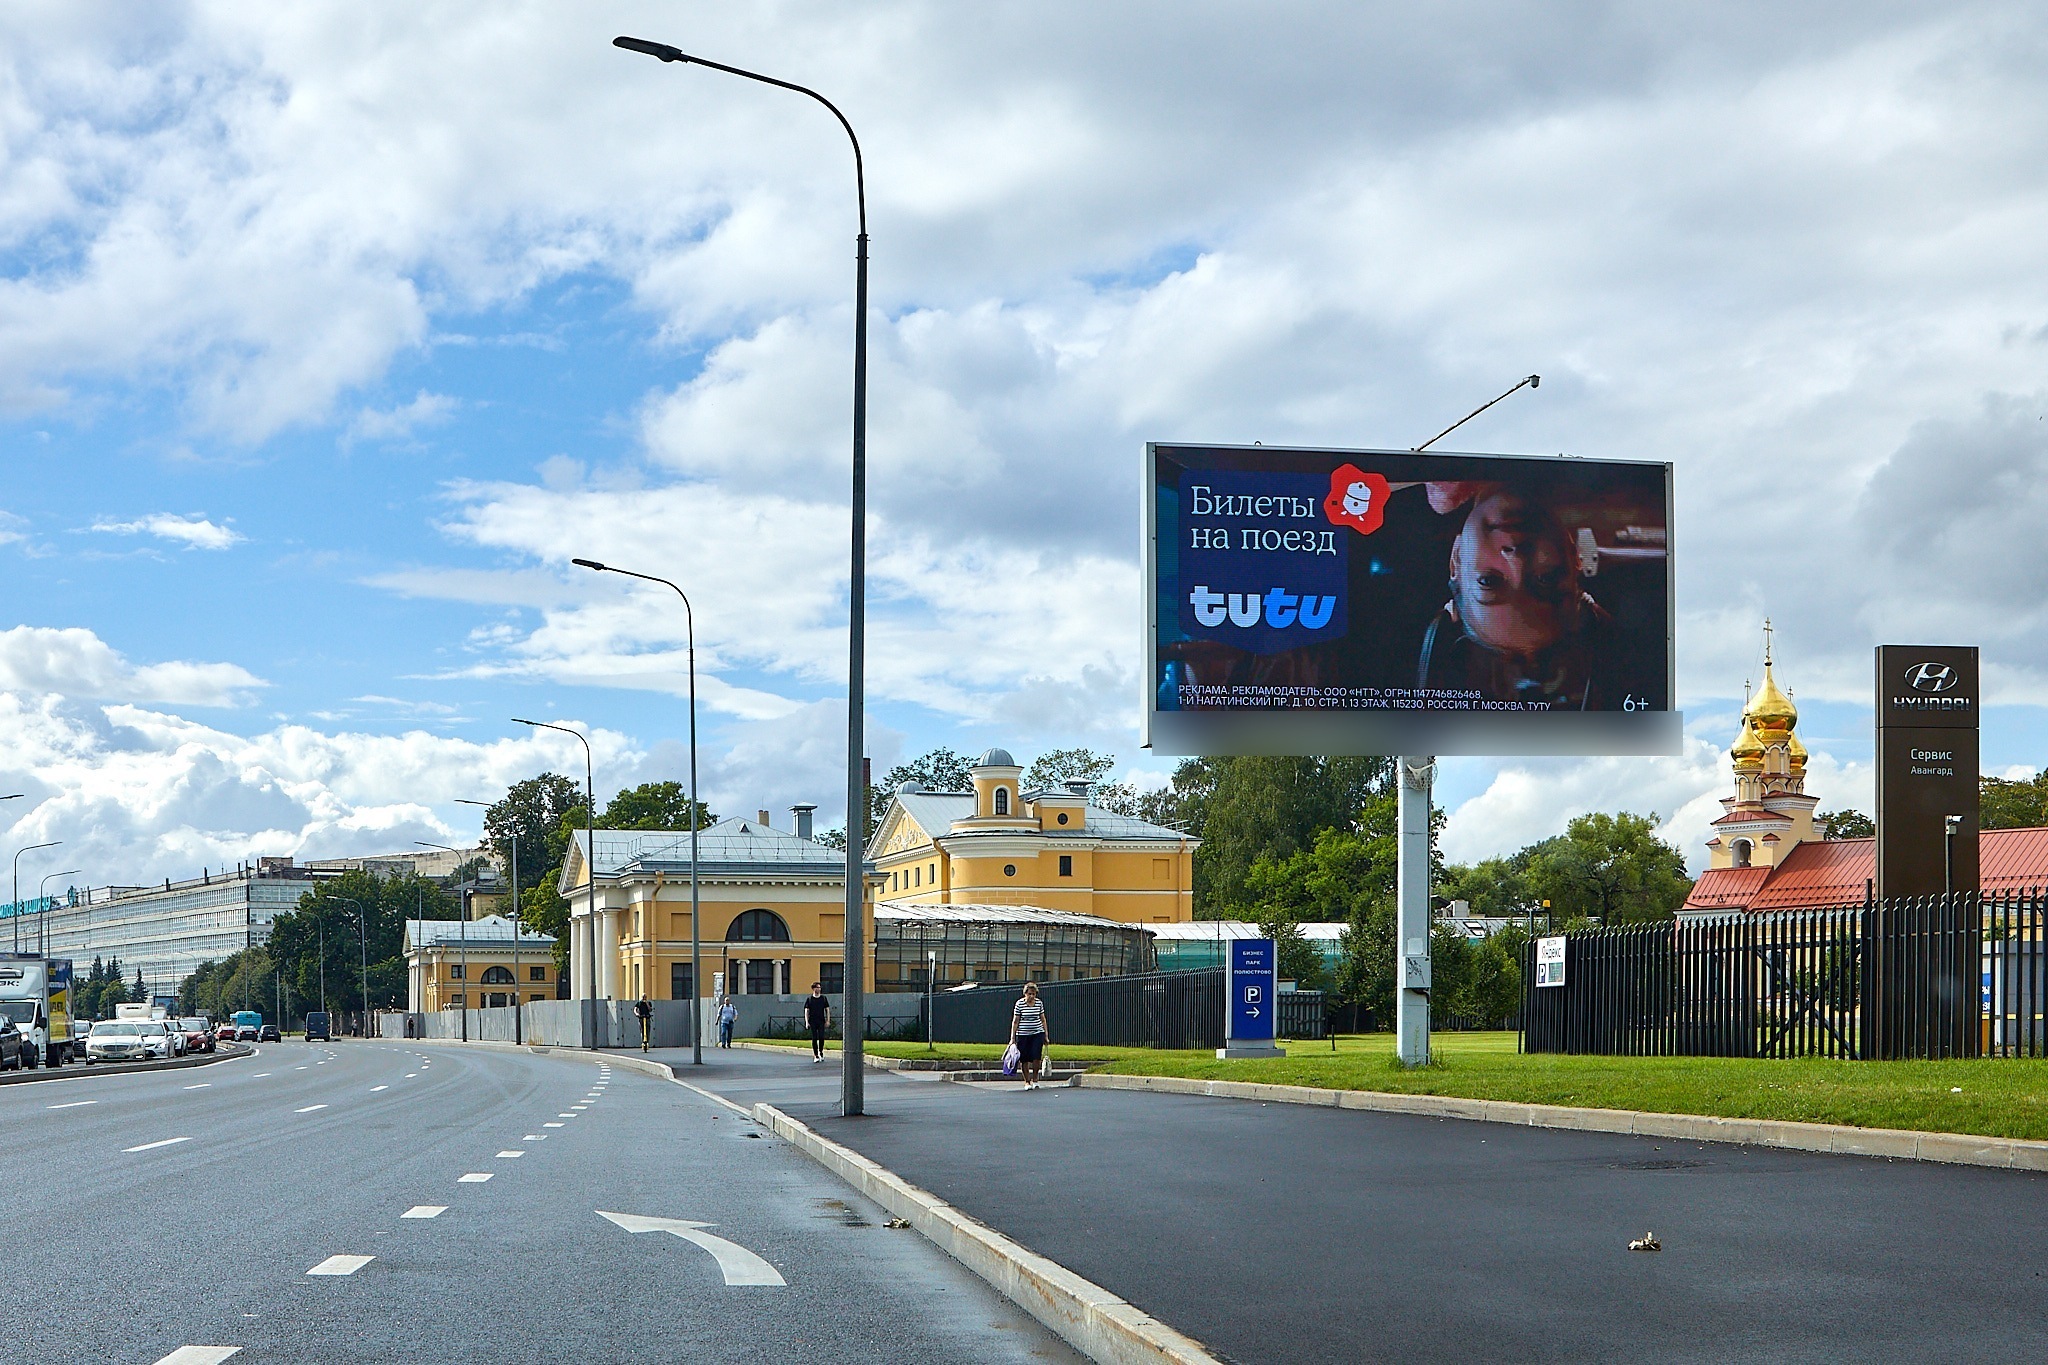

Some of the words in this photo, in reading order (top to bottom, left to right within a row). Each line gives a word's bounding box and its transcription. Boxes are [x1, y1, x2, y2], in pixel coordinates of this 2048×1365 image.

[1190, 486, 1316, 517] Билеты
[1190, 528, 1230, 550] на
[1241, 529, 1337, 556] поезд
[1189, 585, 1337, 630] tutu
[1178, 684, 1230, 695] РЕКЛАМА.
[1232, 685, 1322, 697] РЕКЛАМОДАТЕЛЬ:
[1324, 687, 1347, 696] ООО
[1384, 688, 1411, 698] ОГРН
[1178, 694, 1194, 705] 1-Й
[1196, 695, 1271, 706] НАГАТИНСКИЙ
[1318, 698, 1340, 707] СТР.
[1350, 699, 1359, 708] 13
[1527, 702, 1551, 711] ТУТУ
[1623, 694, 1649, 711] 6+
[1893, 697, 1970, 710] HYUNDAI
[1910, 748, 1953, 762] Сервис
[1910, 765, 1953, 776] Авангард
